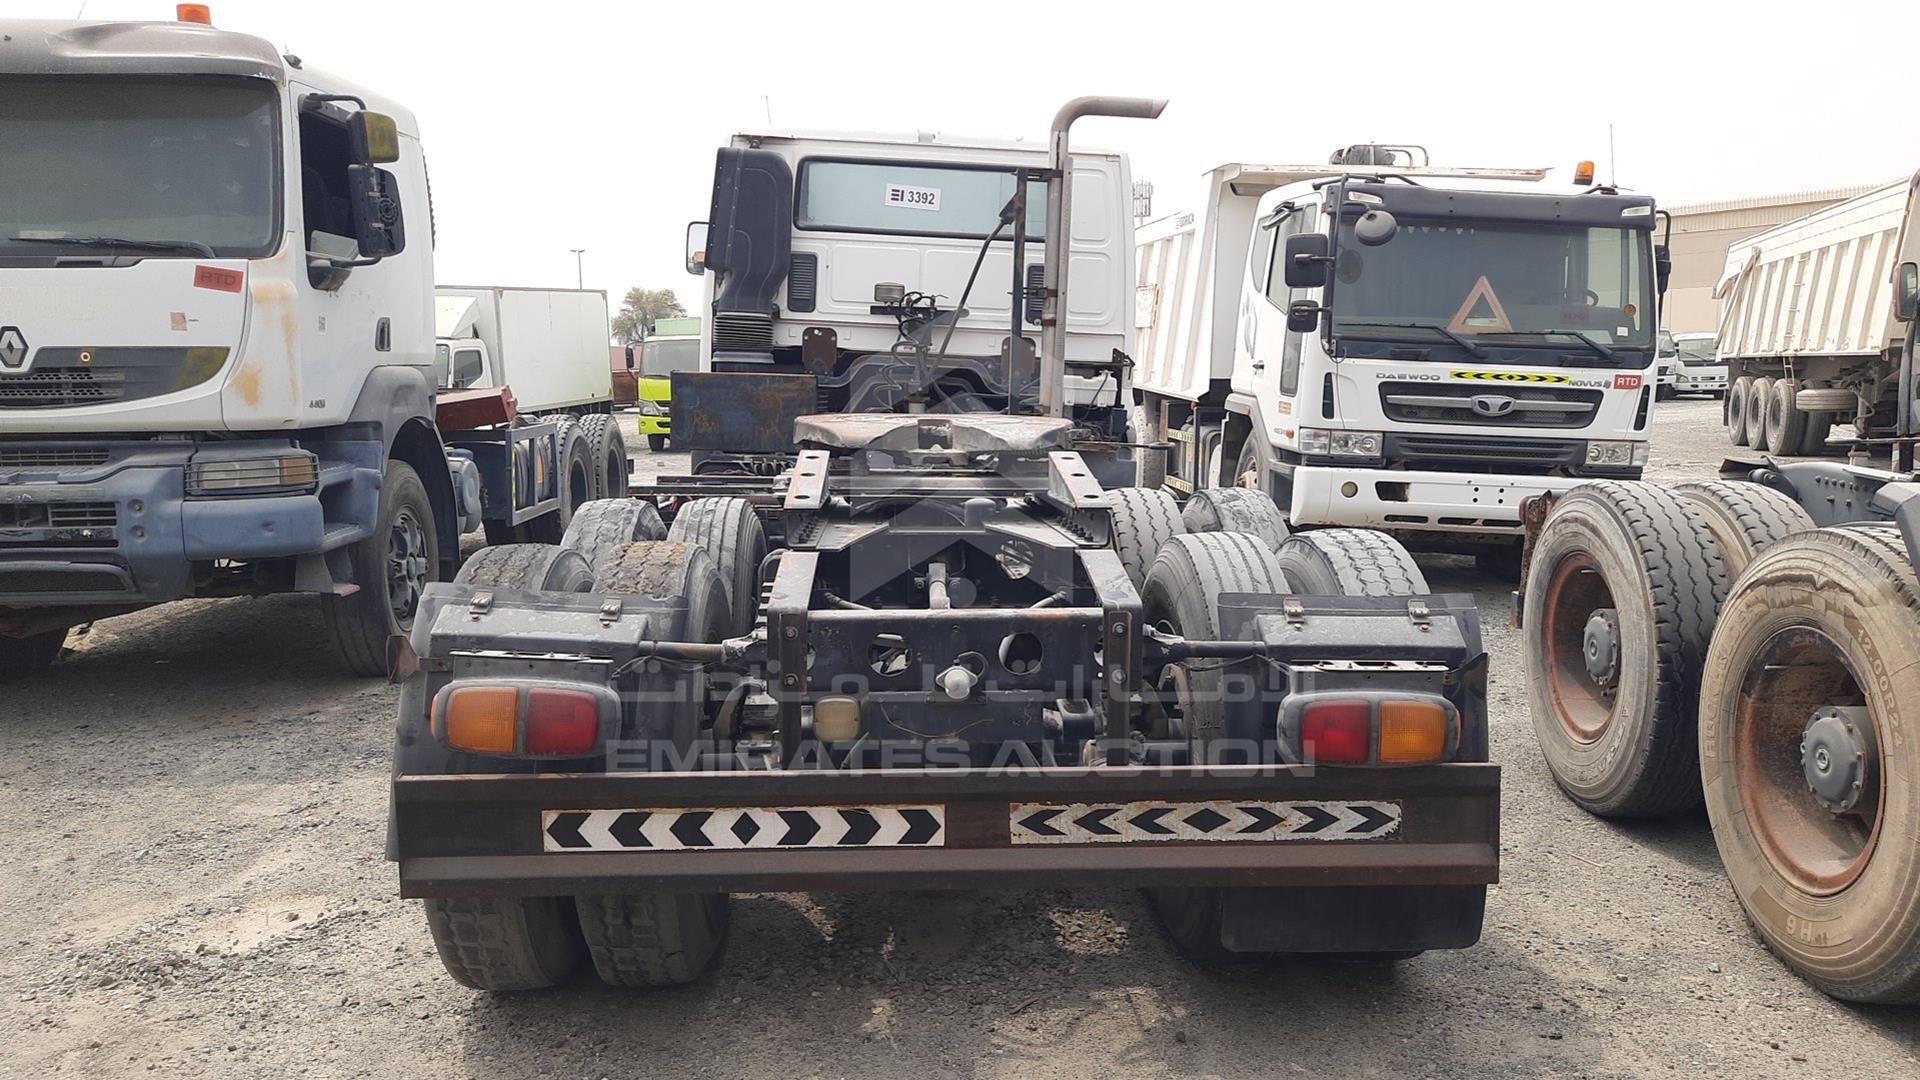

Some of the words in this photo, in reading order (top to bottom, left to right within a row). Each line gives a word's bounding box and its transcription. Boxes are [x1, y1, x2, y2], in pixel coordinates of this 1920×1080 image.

[908, 191, 935, 205] 3392
[201, 271, 236, 286] RTD
[1376, 373, 1441, 381] DAEWOO
[1617, 377, 1638, 386] RTD
[1856, 628, 1904, 746] 12.00R24
